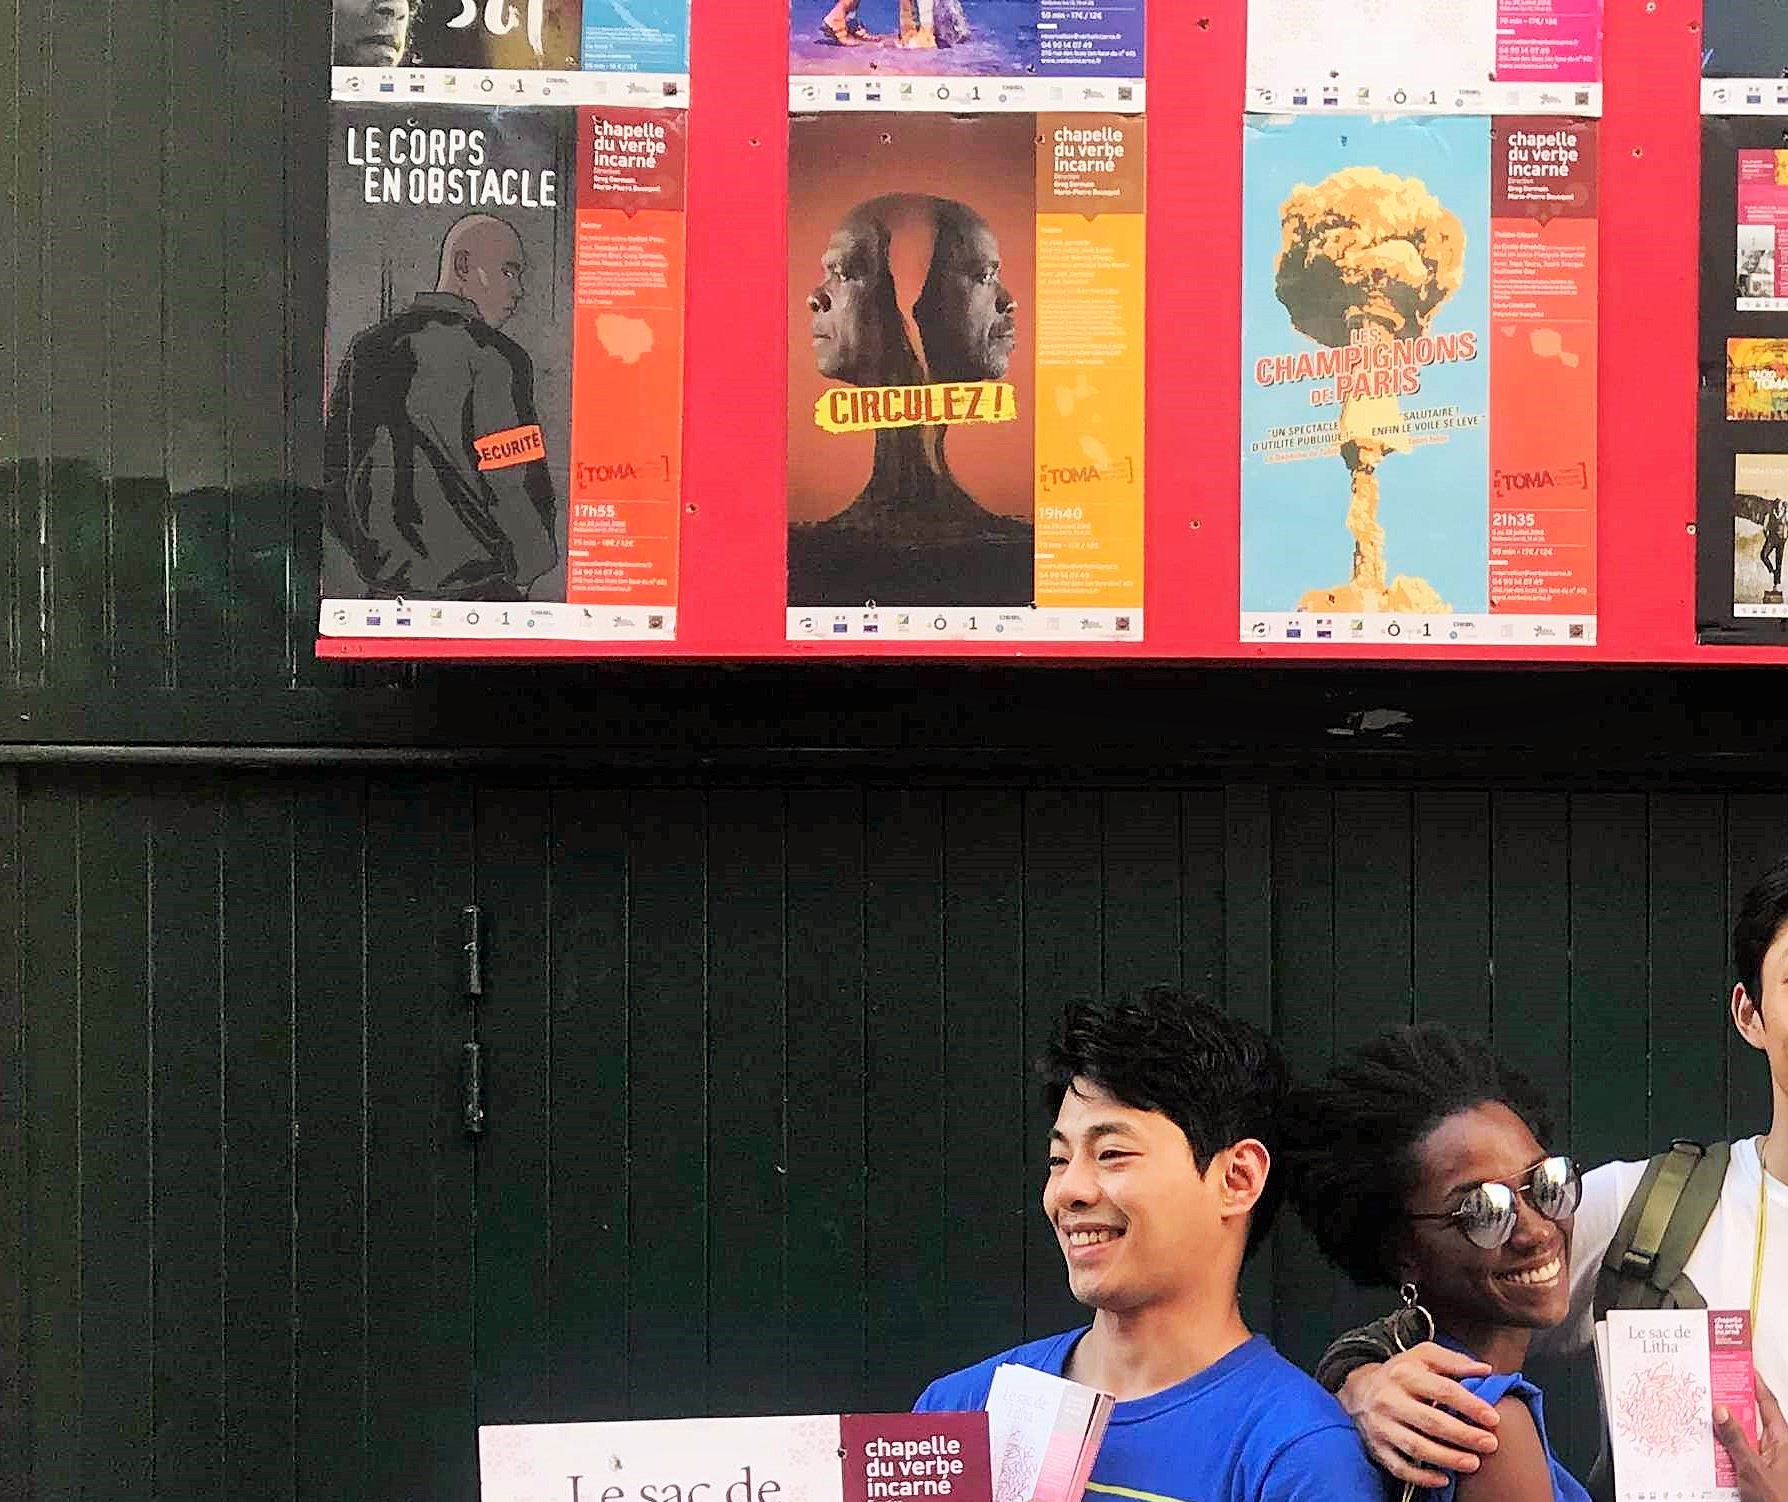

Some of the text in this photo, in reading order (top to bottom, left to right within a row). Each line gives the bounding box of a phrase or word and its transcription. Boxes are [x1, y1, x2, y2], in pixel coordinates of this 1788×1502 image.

[594, 120, 665, 140] chapelle
[1054, 125, 1123, 145] chapelle
[1508, 130, 1578, 149] chapelle
[347, 126, 485, 167] LE CORPS
[594, 135, 667, 154] du verbe
[1054, 141, 1125, 158] du verbe
[1508, 145, 1579, 162] du verbe
[594, 151, 657, 169] incarné
[1054, 156, 1116, 172] incarné
[1508, 160, 1570, 177] incarné
[364, 166, 558, 208] EN OBSTACLE
[1351, 328, 1381, 346] LES
[1255, 331, 1477, 387] CHAMPIGNONS
[1335, 366, 1420, 404] PARIS
[829, 386, 984, 425] CIRCULEZ
[573, 504, 616, 518] 17h55
[1038, 506, 1084, 520] 19h40
[1492, 512, 1535, 527] 21h35
[1628, 1324, 1692, 1340] Le sac de
[1642, 1338, 1679, 1354] Litha
[864, 1434, 961, 1461] chapelle
[865, 1454, 964, 1478] du verbe
[866, 1473, 952, 1498] incarné
